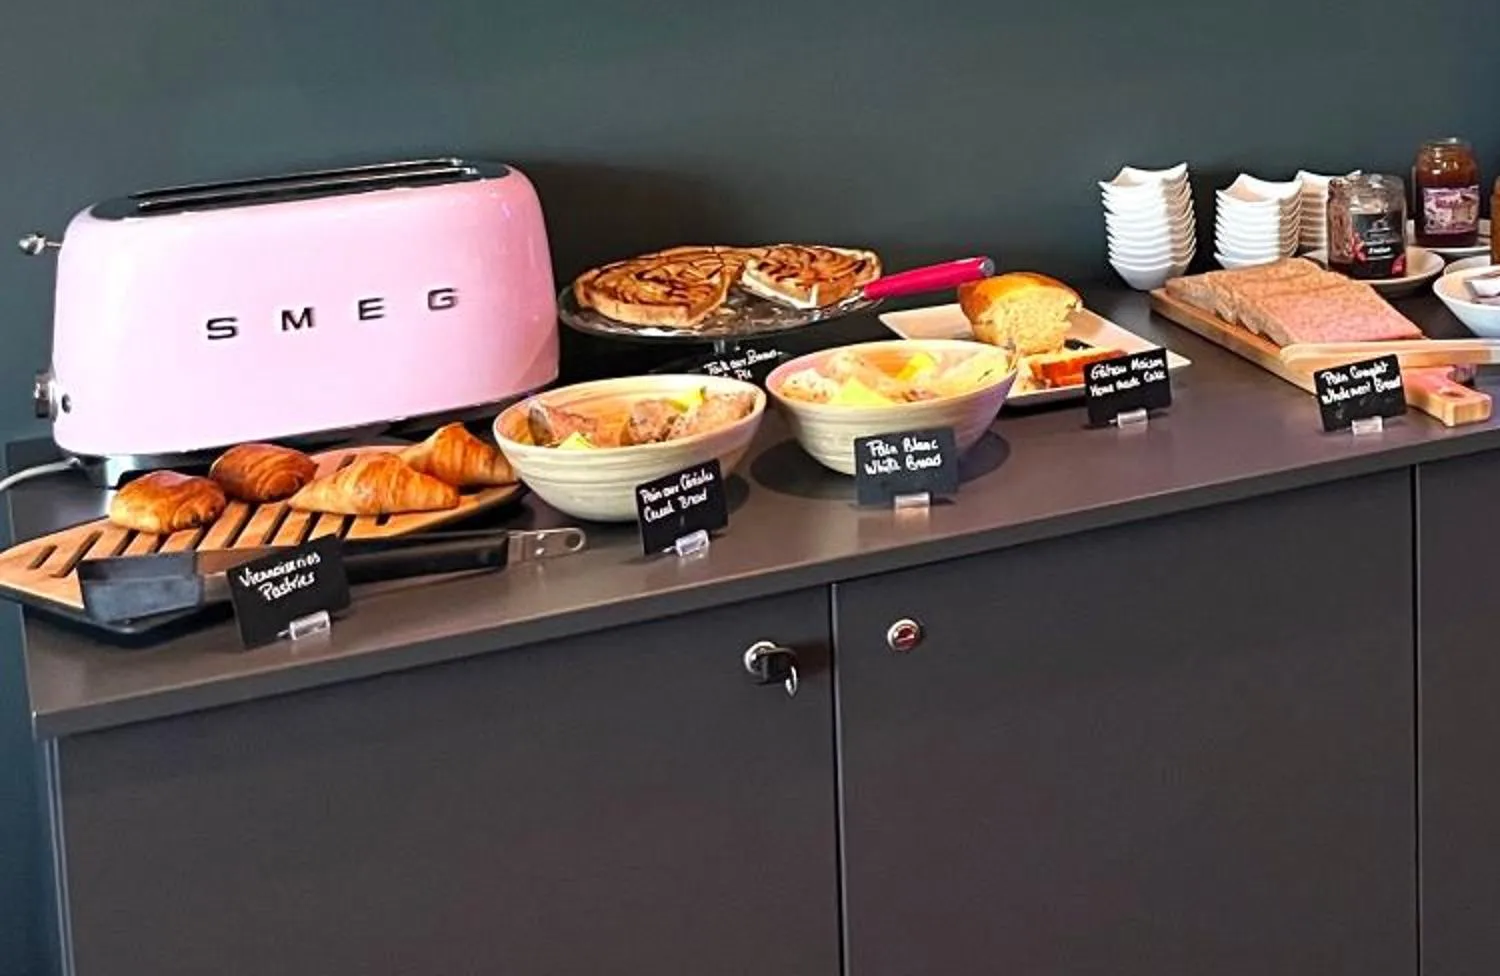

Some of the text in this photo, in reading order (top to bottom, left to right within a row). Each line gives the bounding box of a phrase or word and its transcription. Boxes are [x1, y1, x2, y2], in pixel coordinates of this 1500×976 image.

[206, 287, 459, 341] SMEG
[866, 439, 899, 457] Pain
[258, 571, 316, 601] Pastries
